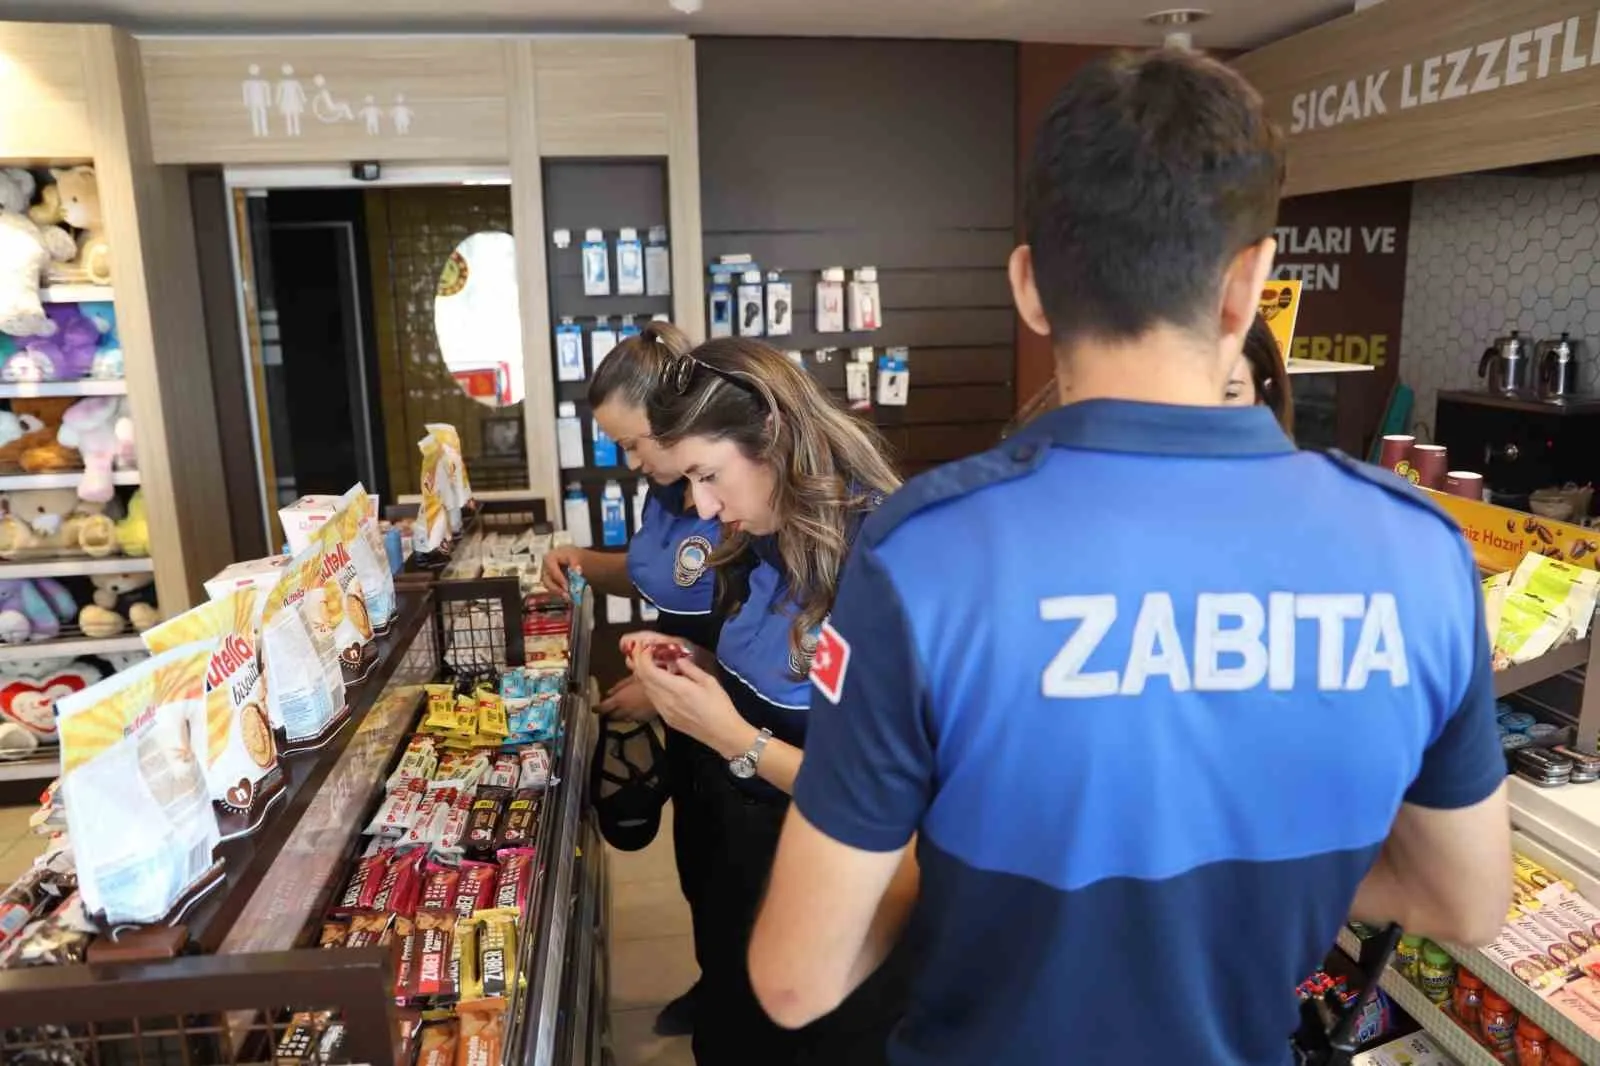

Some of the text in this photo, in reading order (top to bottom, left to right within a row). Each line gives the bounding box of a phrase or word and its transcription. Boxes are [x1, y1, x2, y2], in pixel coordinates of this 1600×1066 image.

[1290, 70, 1390, 134] SICAK
[1361, 227, 1396, 254] VE
[1039, 591, 1410, 698] ZABITA
